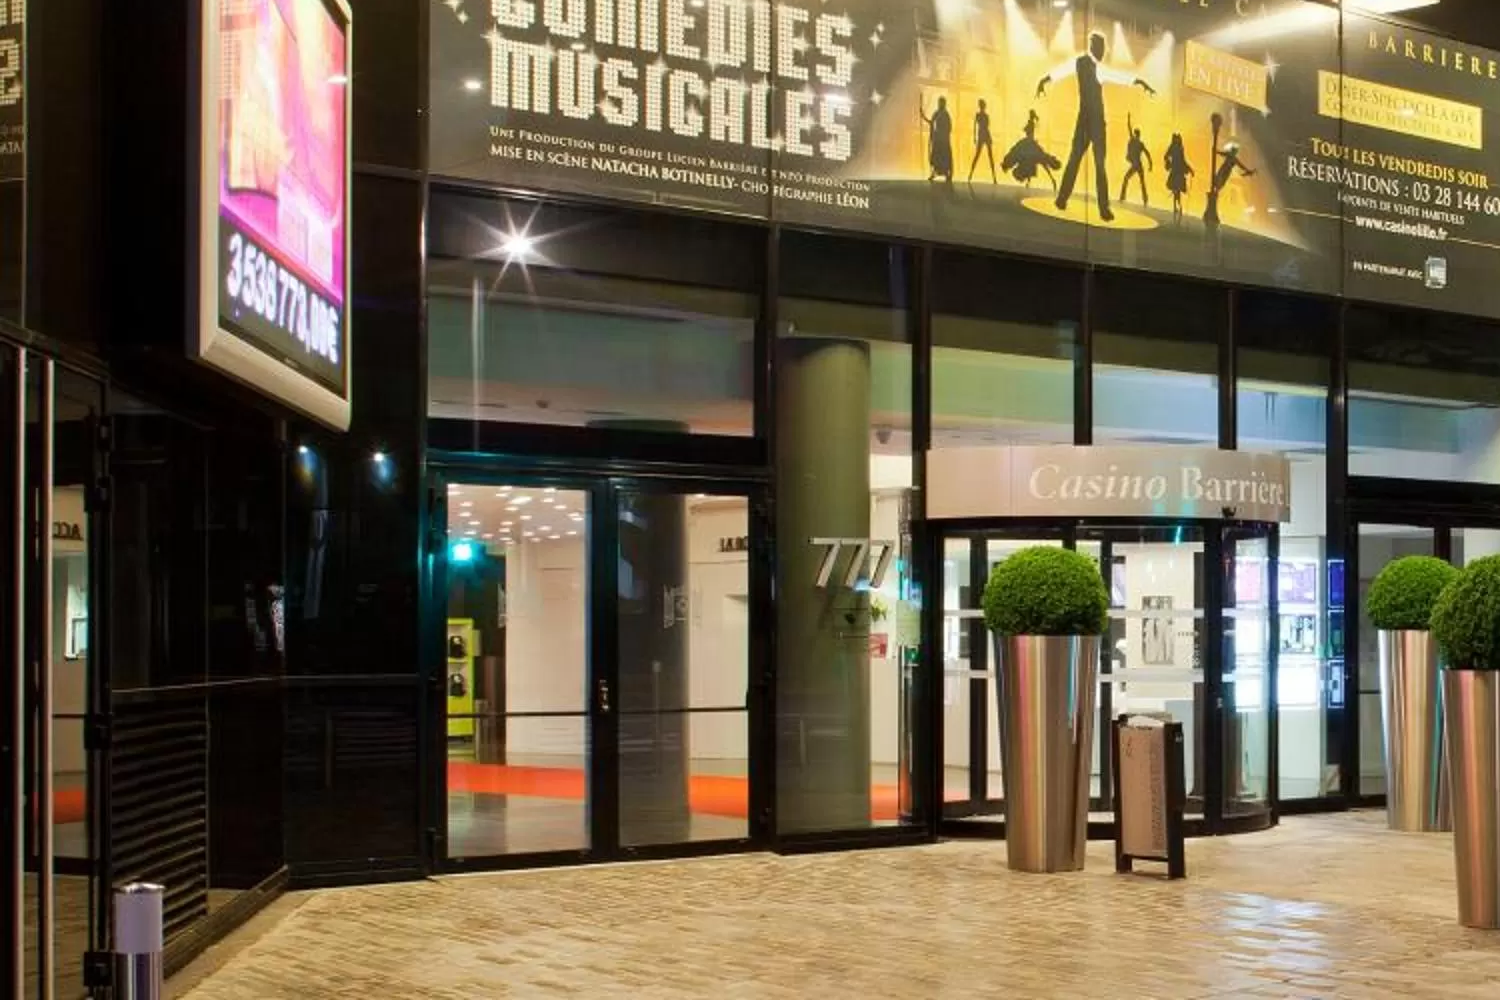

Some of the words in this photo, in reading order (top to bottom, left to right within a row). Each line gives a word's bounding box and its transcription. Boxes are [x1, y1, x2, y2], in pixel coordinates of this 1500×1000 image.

[1369, 31, 1497, 79] BARRIERE
[490, 38, 853, 162] MUSICALES
[490, 144, 523, 160] MISE
[526, 149, 544, 162] EN
[547, 151, 589, 169] SCÈNE
[592, 157, 659, 179] NATACHA
[519, 129, 595, 151] PRODUCTION
[599, 143, 615, 153] DU
[619, 145, 663, 161] GROUPE
[1288, 155, 1400, 197] RÉSERVATIONS
[1413, 182, 1431, 203] 03
[1435, 186, 1452, 207] 28
[1457, 190, 1480, 212] 144
[1353, 149, 1375, 168] LES
[1379, 154, 1454, 184] VENDREDIS
[1457, 171, 1489, 189] SOIR
[1028, 463, 1168, 501] Casino
